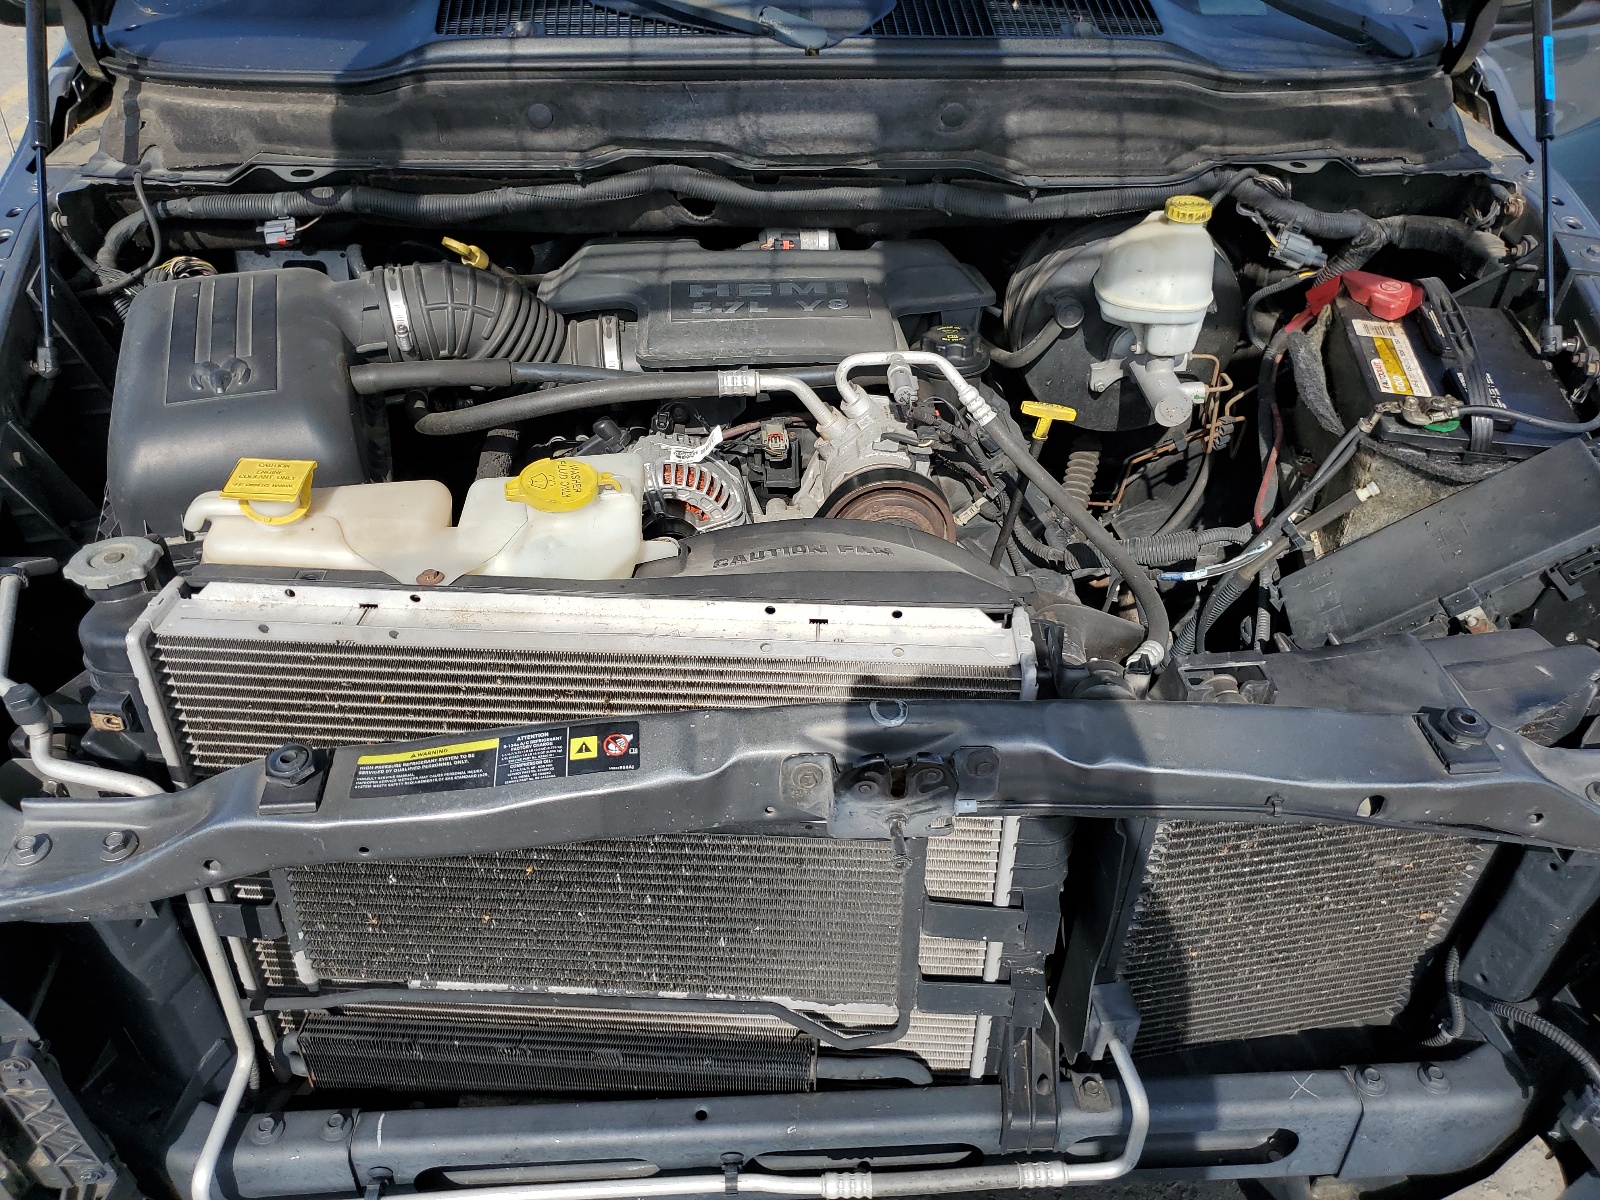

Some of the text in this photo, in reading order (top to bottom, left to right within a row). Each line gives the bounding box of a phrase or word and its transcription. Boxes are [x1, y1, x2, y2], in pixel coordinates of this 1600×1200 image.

[688, 282, 848, 298] HEMI
[692, 298, 849, 314] 5.7L V8
[557, 460, 571, 498] FLUID ONLY
[569, 464, 582, 493] WASHER
[712, 544, 895, 569] CAUTION FAN
[516, 732, 549, 741] ATTENTION
[417, 748, 448, 757] WARNING
[510, 743, 532, 751] FACTORY
[402, 758, 437, 767] REFRIGERANT
[393, 765, 421, 773] QUALIFIED
